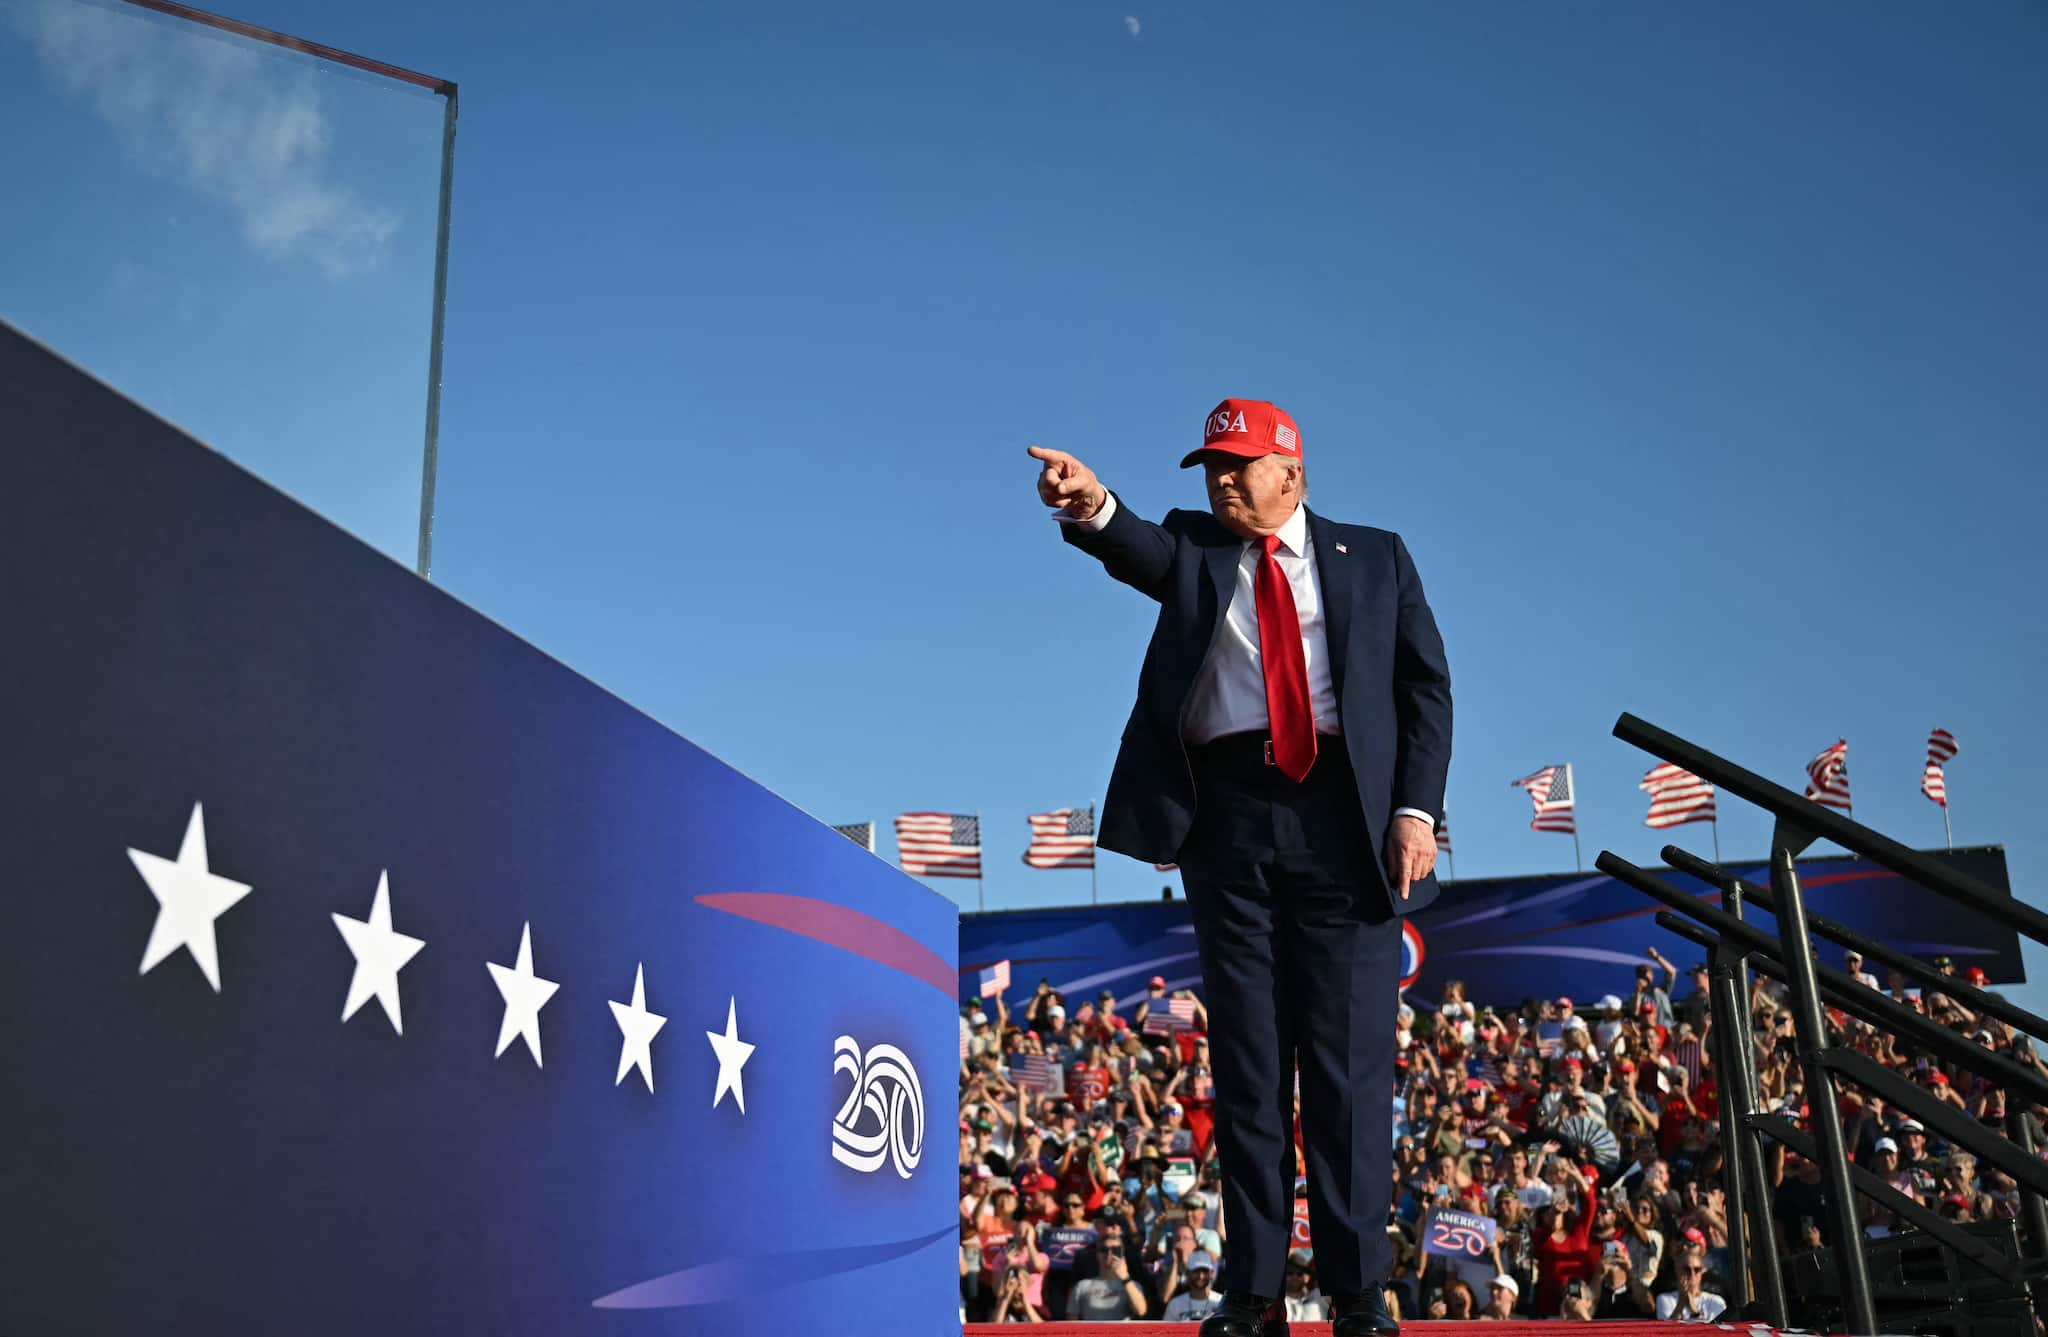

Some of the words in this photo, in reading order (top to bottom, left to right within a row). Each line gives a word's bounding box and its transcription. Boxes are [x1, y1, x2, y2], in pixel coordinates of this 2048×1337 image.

[1205, 410, 1248, 437] USA
[832, 1035, 924, 1179] 250
[1436, 1212, 1486, 1231] AMERICA
[1433, 1223, 1488, 1256] 250
